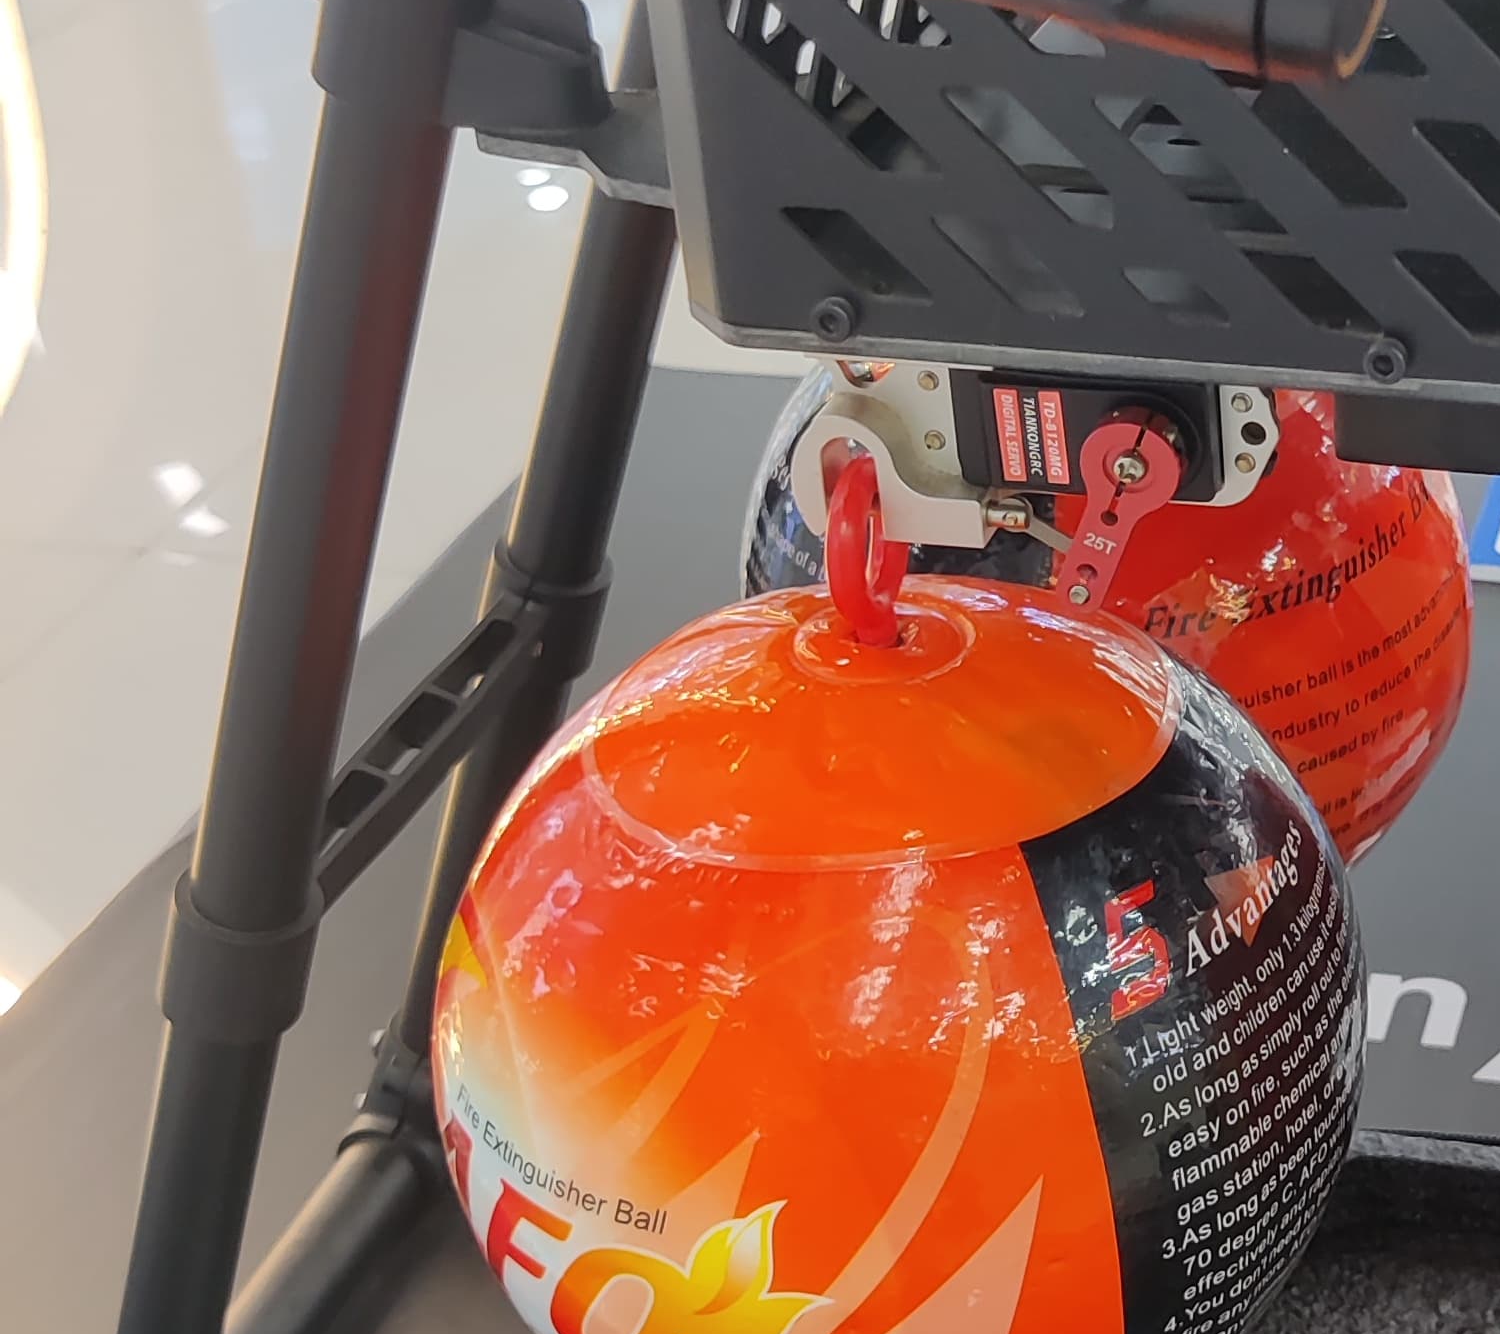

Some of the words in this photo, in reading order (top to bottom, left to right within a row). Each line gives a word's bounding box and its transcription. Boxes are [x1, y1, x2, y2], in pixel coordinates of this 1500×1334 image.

[1000, 394, 1016, 437] DIGITAL
[1006, 439, 1021, 476] SERVO
[1023, 397, 1043, 476] TIANKONGRC
[1083, 532, 1117, 555] 25T
[1144, 603, 1217, 639] Fire
[1271, 711, 1340, 743] ndustry
[1345, 699, 1360, 716] to
[1364, 665, 1411, 708] reduce
[1307, 664, 1338, 689] ball
[1341, 659, 1356, 676] is
[1357, 647, 1380, 669] the
[1297, 739, 1357, 774] caused
[1361, 725, 1379, 746] by
[1185, 819, 1302, 977] Advantages
[1104, 879, 1172, 1021] 5
[1255, 948, 1284, 982] only
[1282, 922, 1301, 952] 1.3
[1140, 1098, 1192, 1137] 2.As
[1194, 1068, 1239, 1107] long
[1241, 1052, 1260, 1078] as
[1260, 1007, 1302, 1061] simply
[1302, 981, 1320, 1017] roll
[1319, 959, 1335, 991] out
[1153, 1056, 1188, 1092] old
[1192, 1031, 1231, 1071] and
[1233, 987, 1287, 1045] children
[1286, 961, 1309, 993] can
[1307, 936, 1325, 967] use
[1168, 1116, 1220, 1158] easy
[1225, 1099, 1250, 1126] on
[1282, 1034, 1314, 1078] such
[1314, 1014, 1329, 1040] as
[1327, 988, 1343, 1019] the
[456, 1082, 481, 1130] Fire
[482, 1120, 608, 1216] Extinguisher
[614, 1198, 668, 1235] Ball
[1172, 1114, 1272, 1191] flammable
[1274, 1044, 1331, 1120] chemical
[1162, 1222, 1212, 1260] 3.As
[1217, 1194, 1259, 1232] long
[1260, 1175, 1277, 1202] as
[1279, 1136, 1312, 1182] been
[1177, 1189, 1219, 1226] gas
[1223, 1141, 1285, 1196] station,
[1183, 1248, 1212, 1276] 70
[1218, 1200, 1279, 1258] degree
[1299, 1142, 1328, 1187] AFO
[1183, 1223, 1279, 1301] effectively
[1280, 1189, 1307, 1230] and
[1217, 1293, 1252, 1325] any
